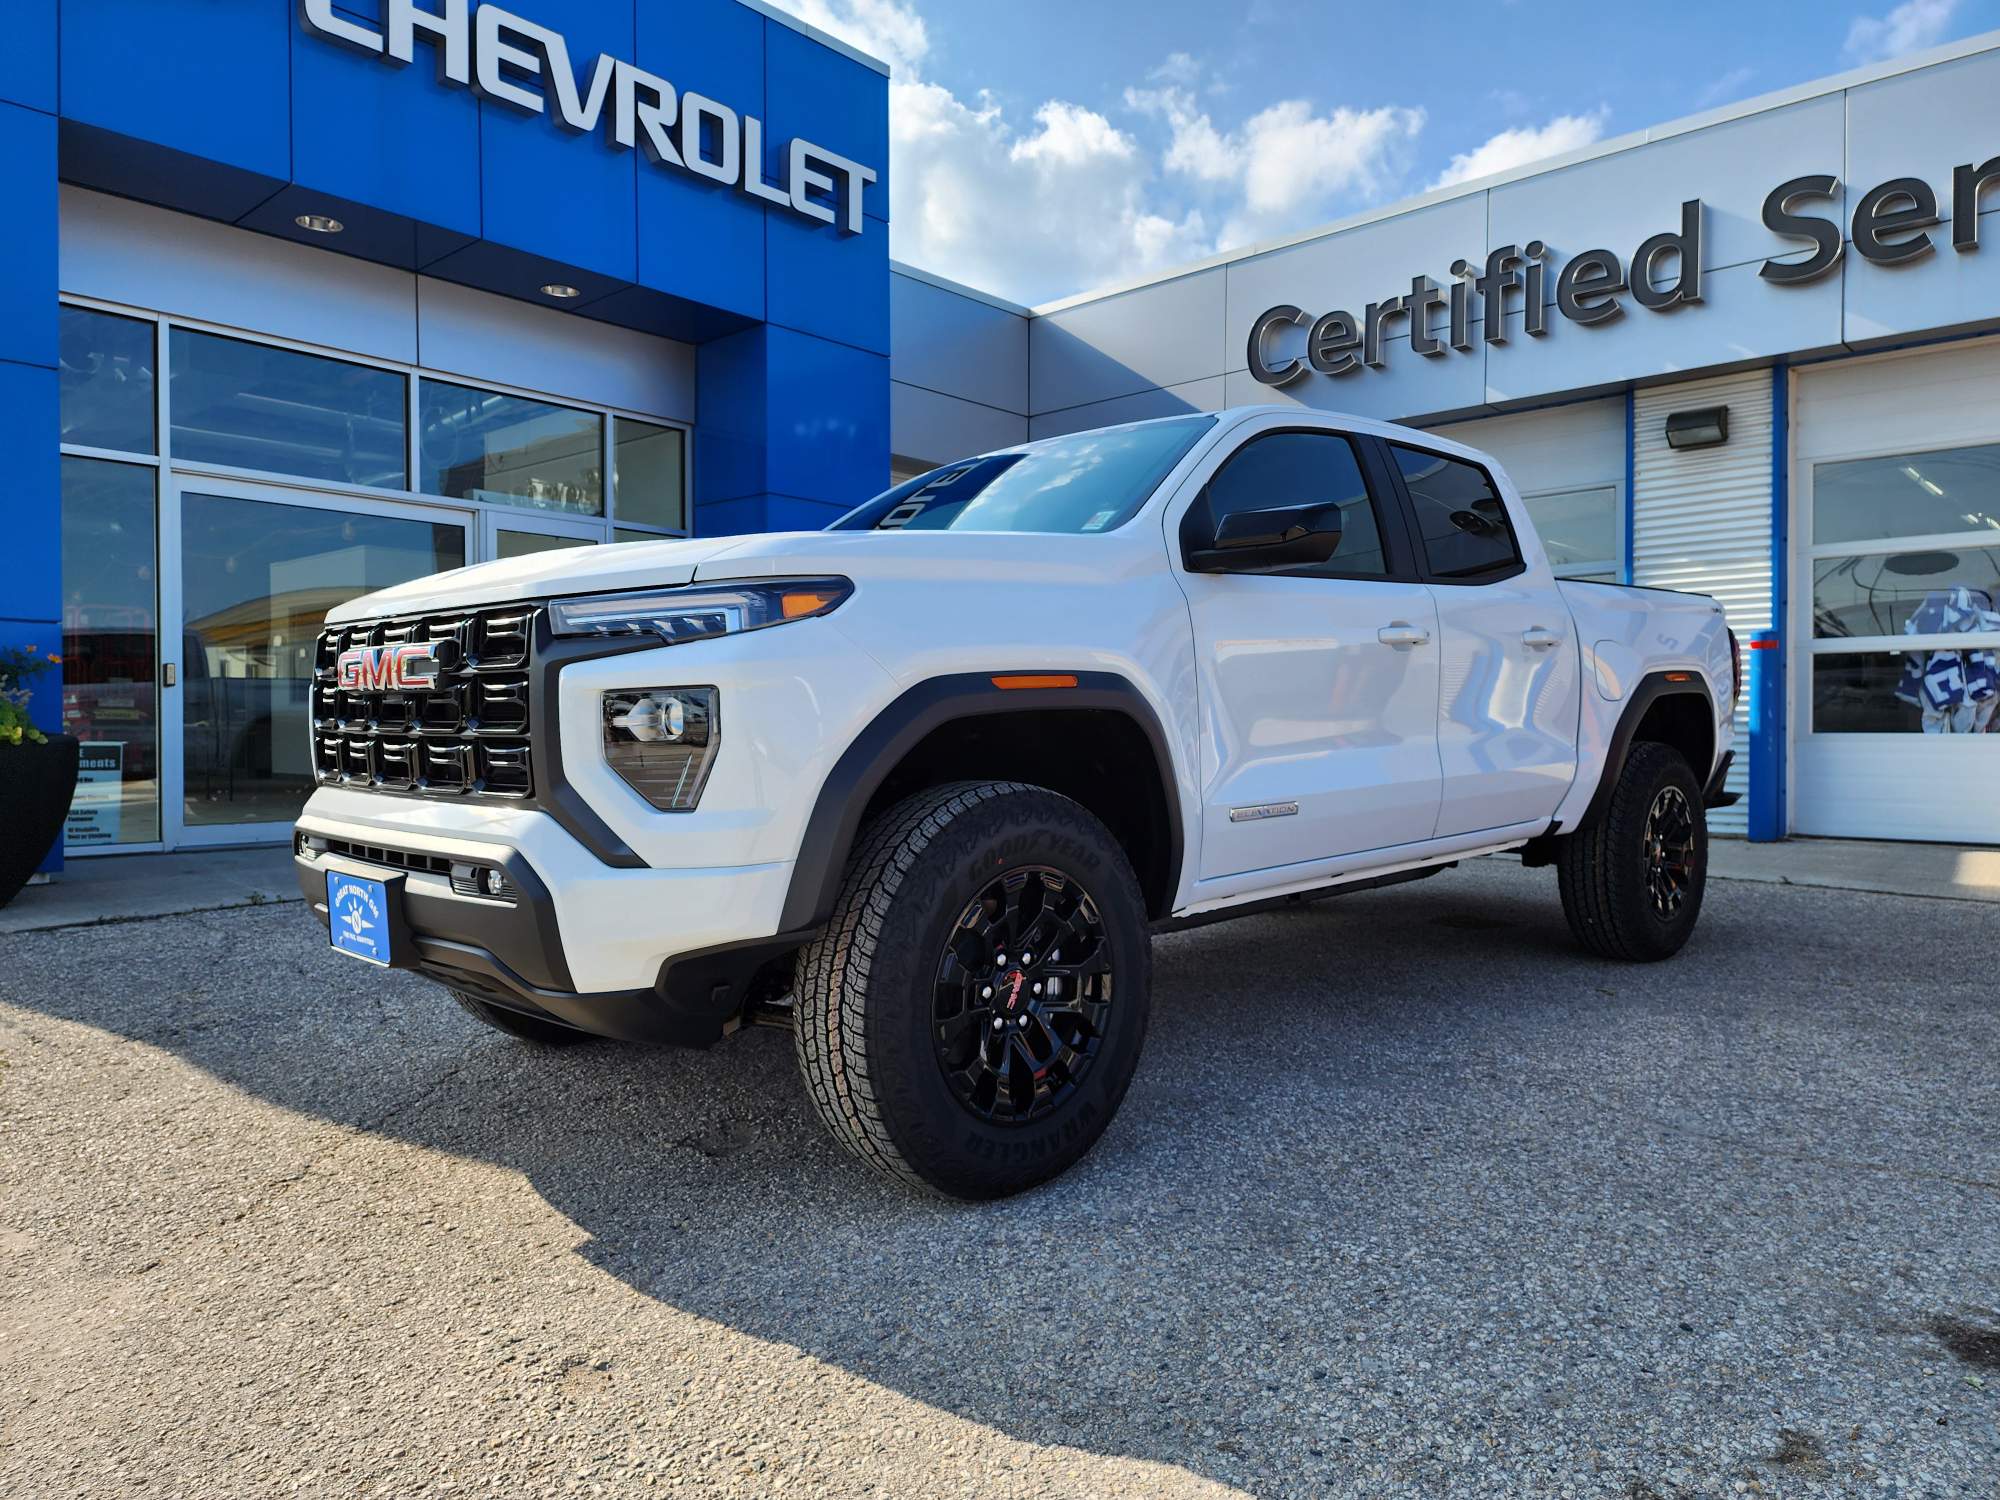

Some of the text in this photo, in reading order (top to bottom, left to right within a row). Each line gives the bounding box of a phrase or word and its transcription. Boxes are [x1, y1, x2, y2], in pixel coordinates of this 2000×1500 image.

[1247, 155, 2000, 387] Certified Ser
[338, 642, 440, 691] GMC
[968, 828, 1101, 882] GOODYEAR
